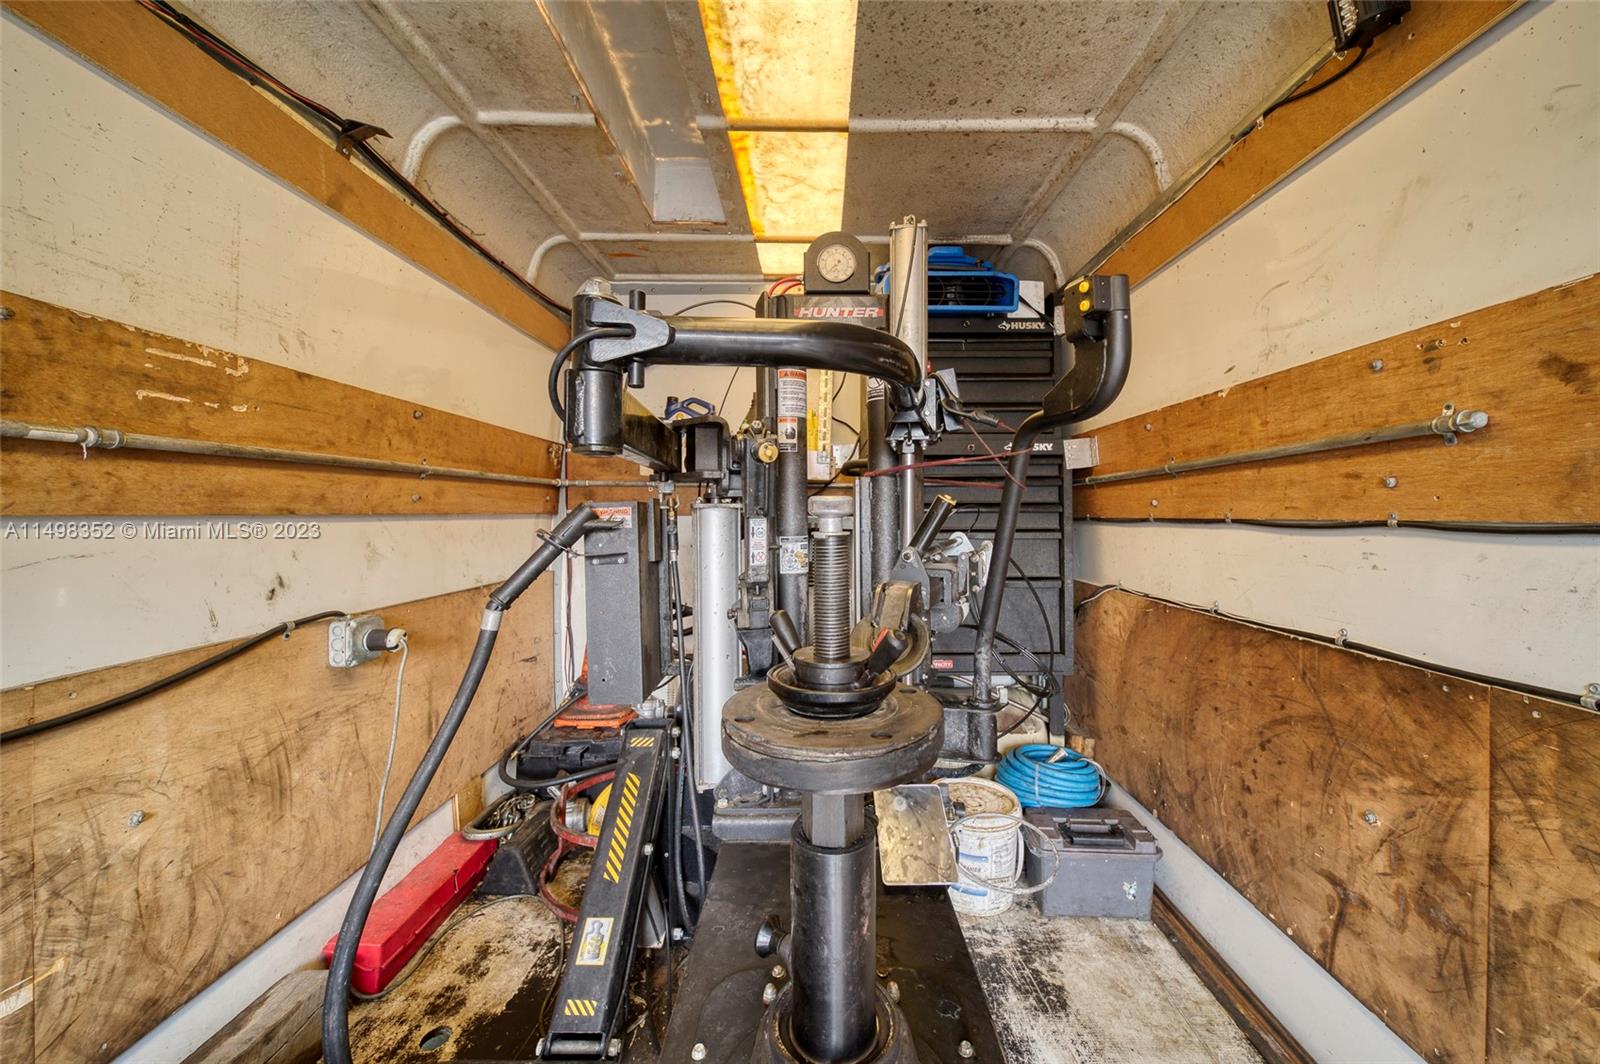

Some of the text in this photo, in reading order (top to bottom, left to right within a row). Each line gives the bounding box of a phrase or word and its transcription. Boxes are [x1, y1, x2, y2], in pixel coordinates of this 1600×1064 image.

[797, 306, 880, 319] HUNTER
[1010, 321, 1046, 331] HUSKY
[1032, 442, 1054, 452] SKY
